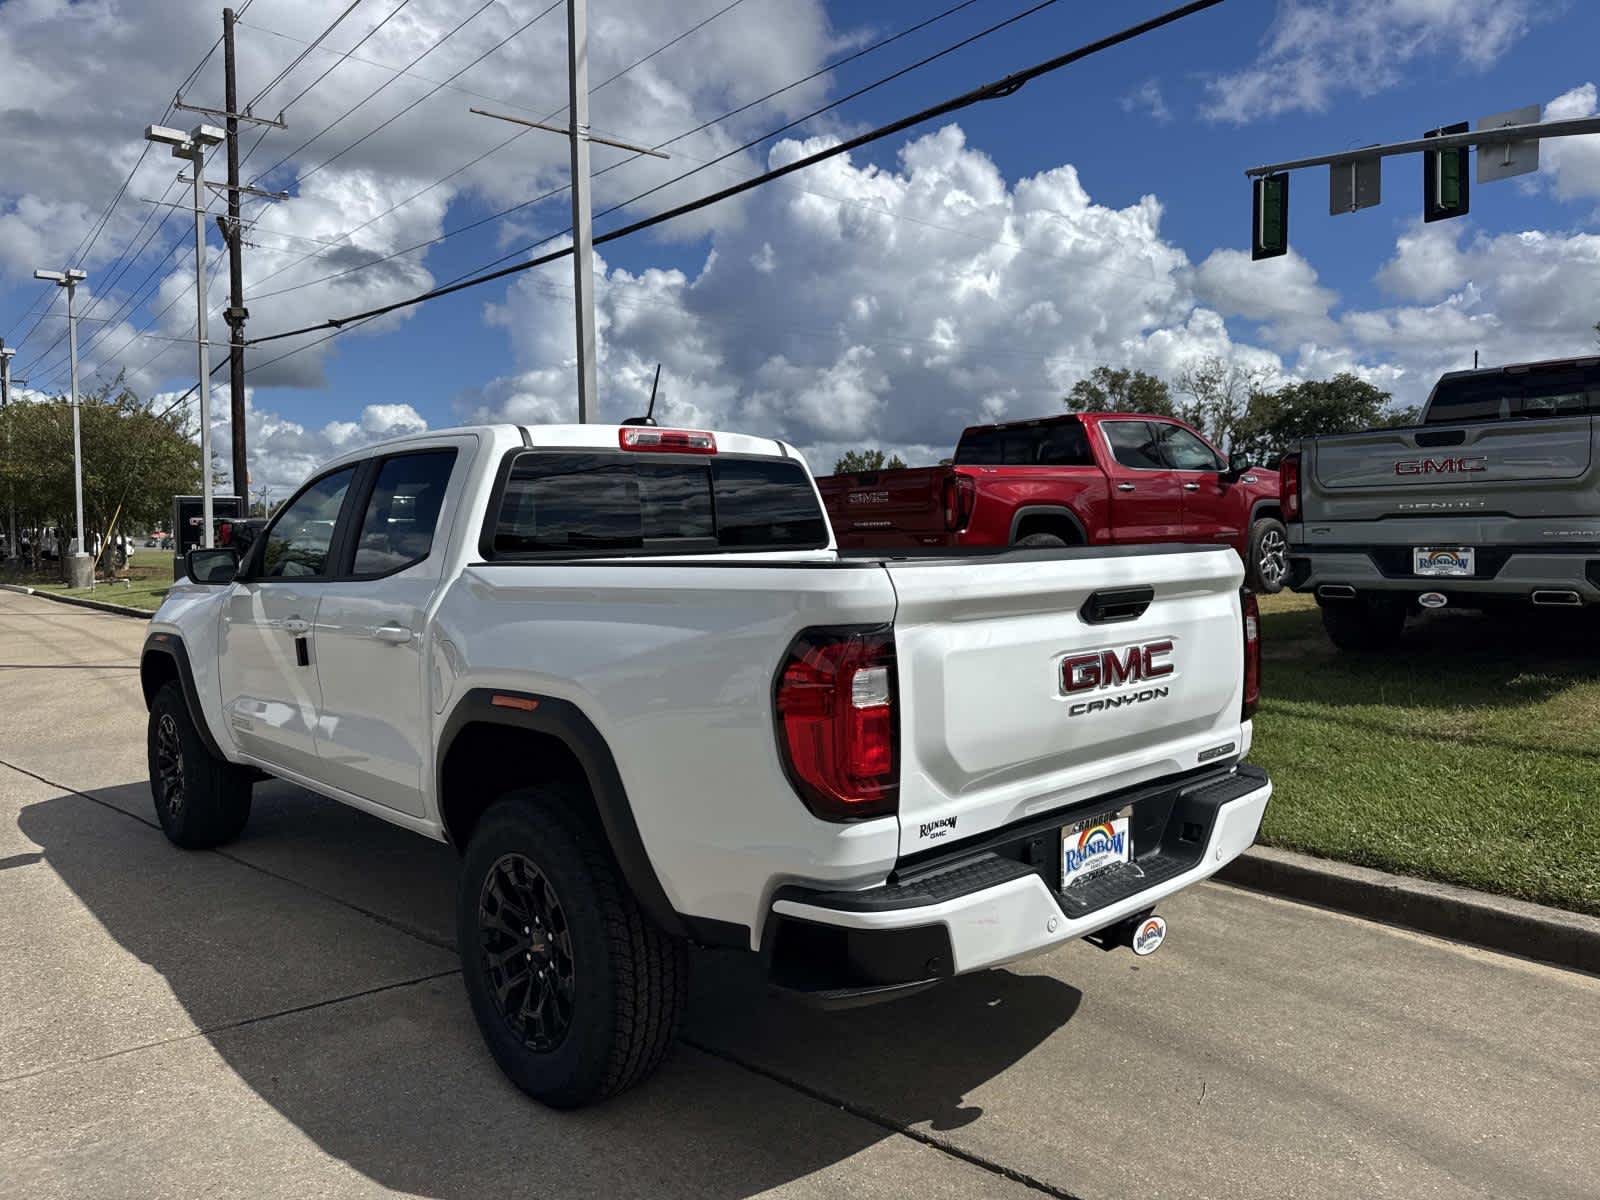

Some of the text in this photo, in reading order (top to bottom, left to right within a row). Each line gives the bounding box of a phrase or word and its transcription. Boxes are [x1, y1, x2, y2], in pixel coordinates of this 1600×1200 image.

[1395, 456, 1488, 475] GMC
[1419, 558, 1469, 570] RAINBOW
[1058, 639, 1175, 697] GMC
[1068, 686, 1169, 717] CANYON
[919, 815, 958, 839] RAINBOW
[930, 829, 947, 839] GMC
[1065, 831, 1125, 873] RAINBOW
